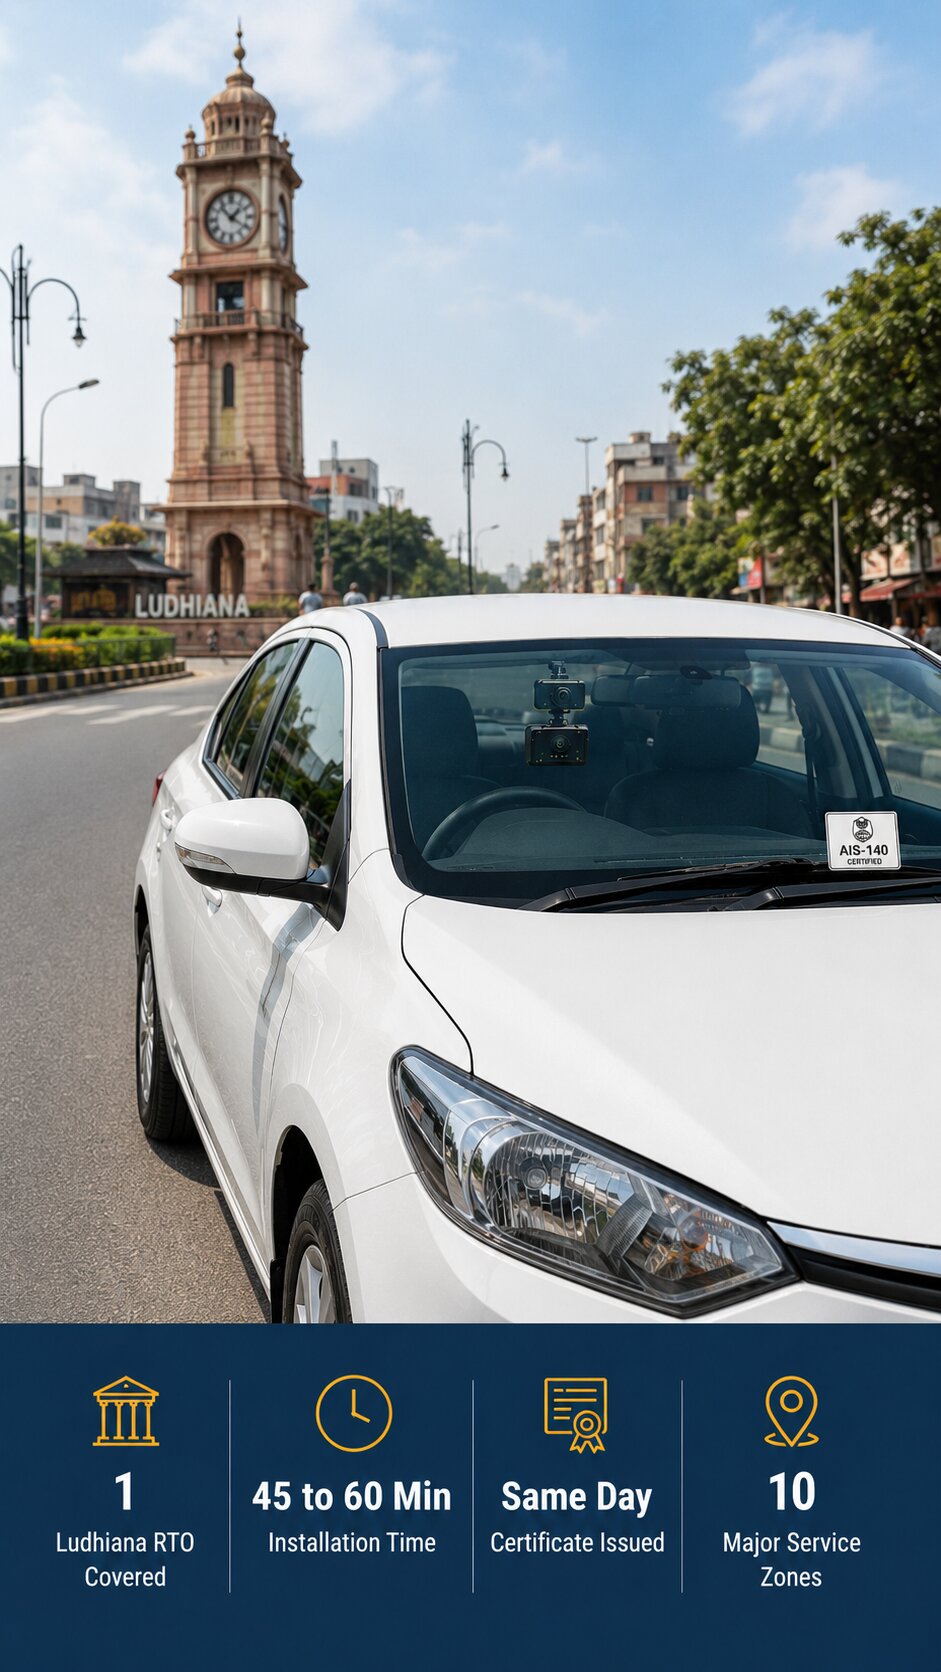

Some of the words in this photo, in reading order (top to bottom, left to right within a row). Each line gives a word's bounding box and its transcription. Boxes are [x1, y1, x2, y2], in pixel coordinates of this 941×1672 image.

[135, 593, 250, 617] LUDHIANA
[839, 844, 888, 856] AIS-140
[847, 857, 882, 865] CERTIFIED
